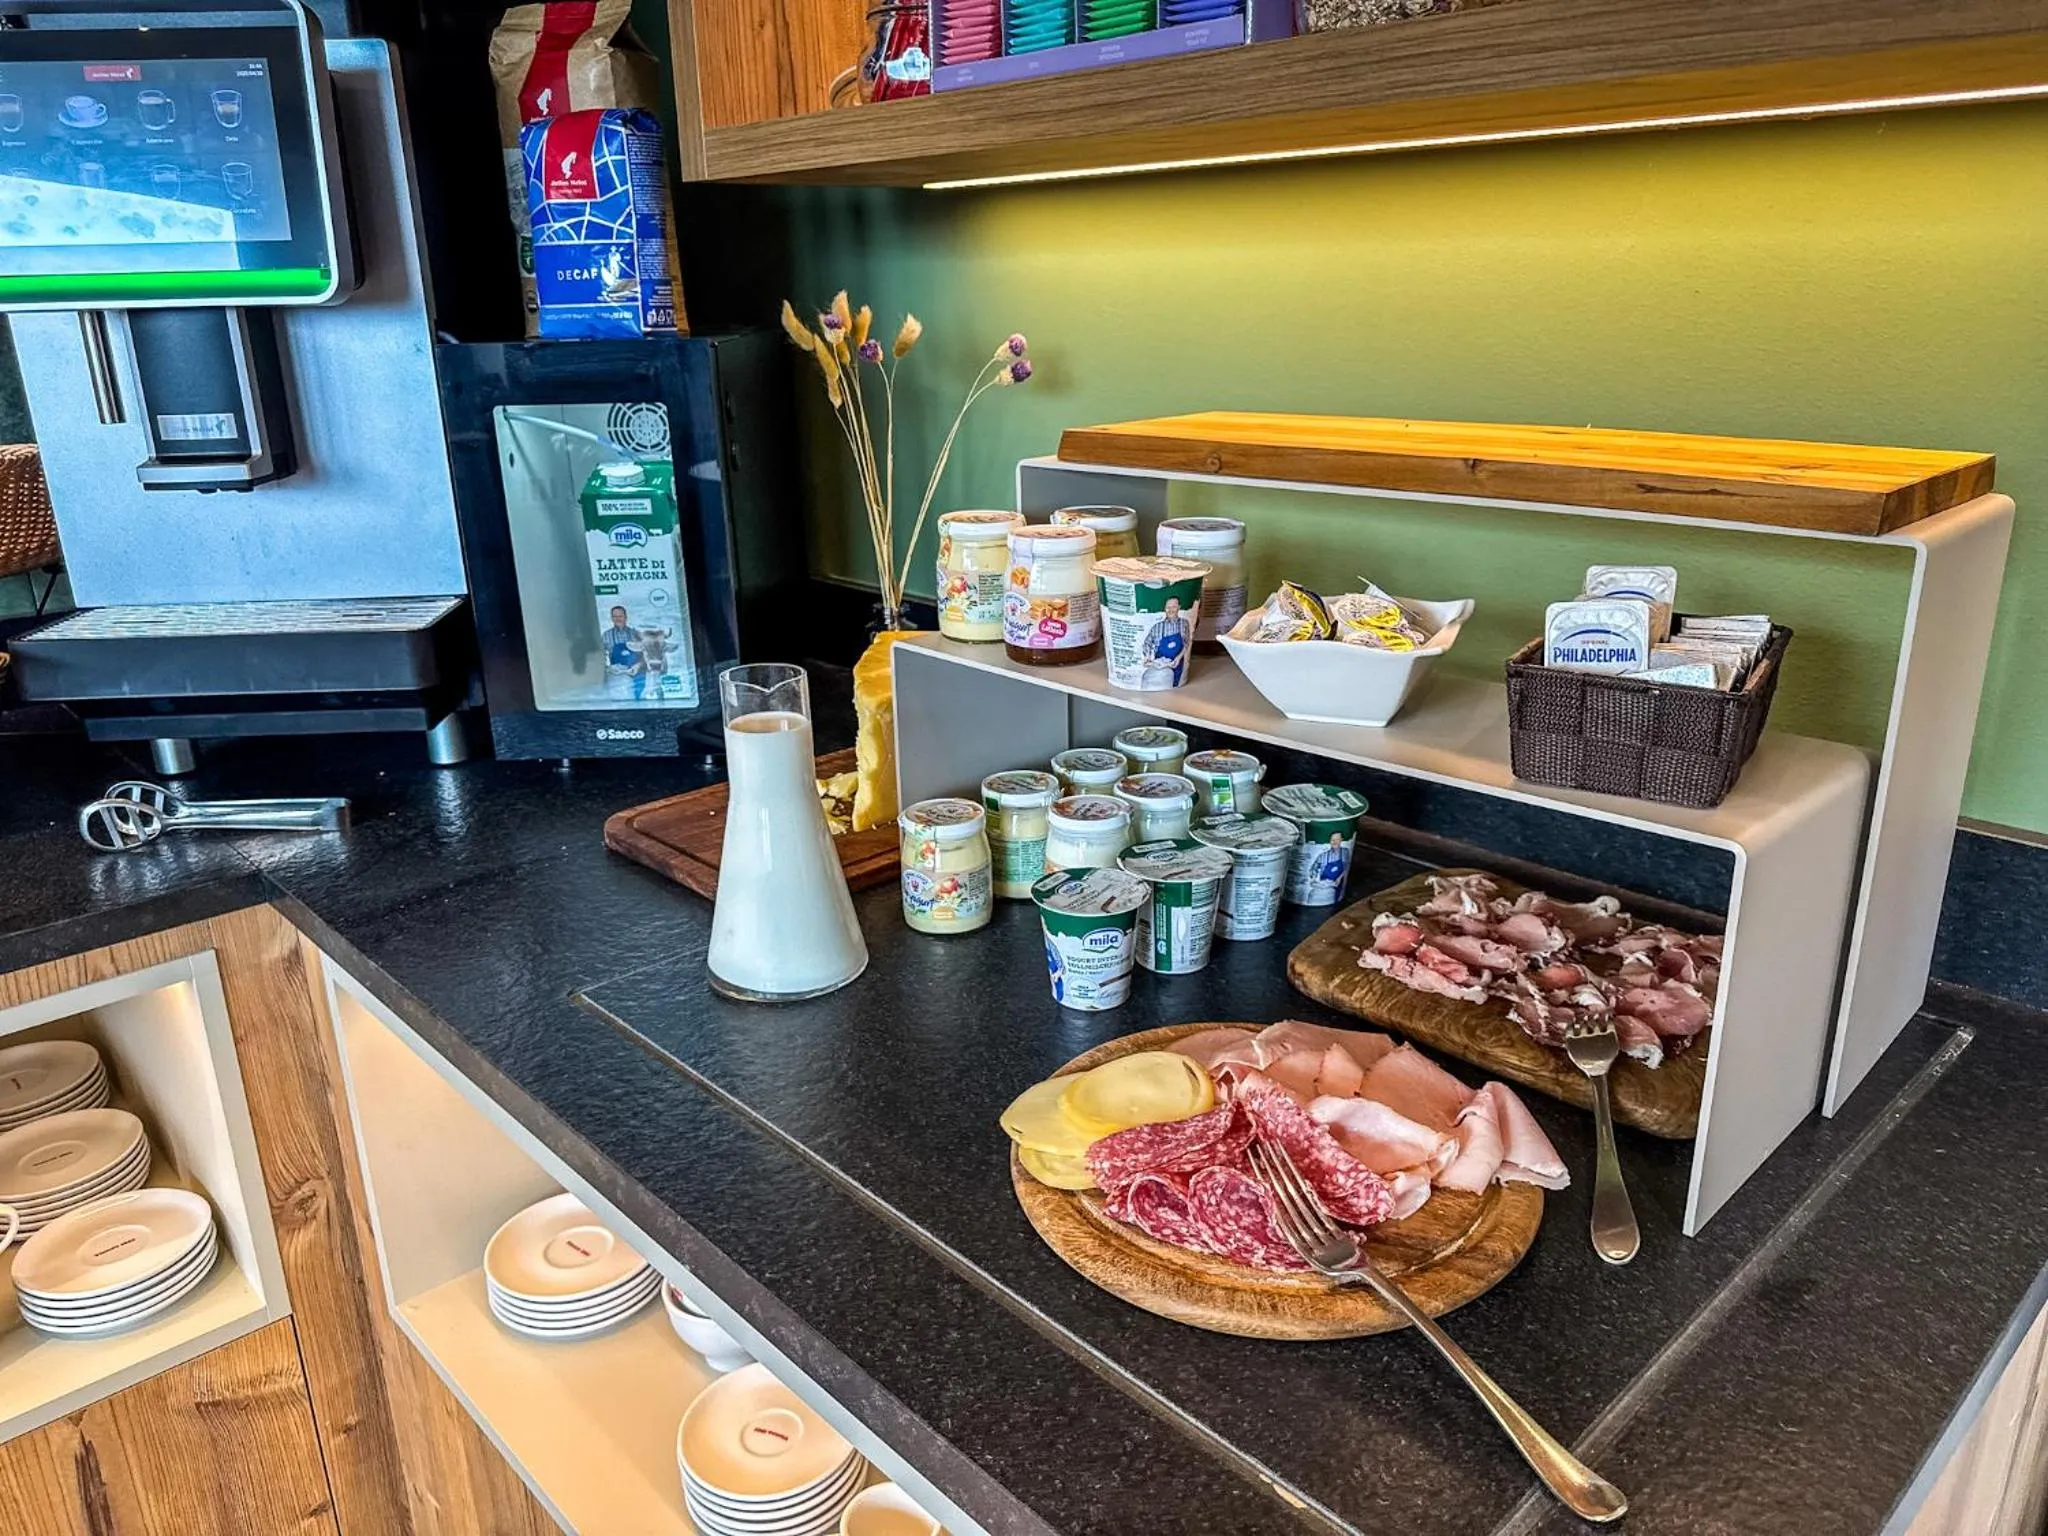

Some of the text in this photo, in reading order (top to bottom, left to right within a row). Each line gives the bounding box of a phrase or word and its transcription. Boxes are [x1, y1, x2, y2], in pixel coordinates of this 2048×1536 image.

[556, 267, 598, 281] DECAF
[614, 528, 642, 540] mila
[596, 557, 666, 570] LATTE DI
[598, 570, 669, 581] MONTAGNA
[1553, 646, 1637, 663] PHILADELPHIA
[608, 728, 645, 740] Saeco
[1090, 934, 1119, 946] mila
